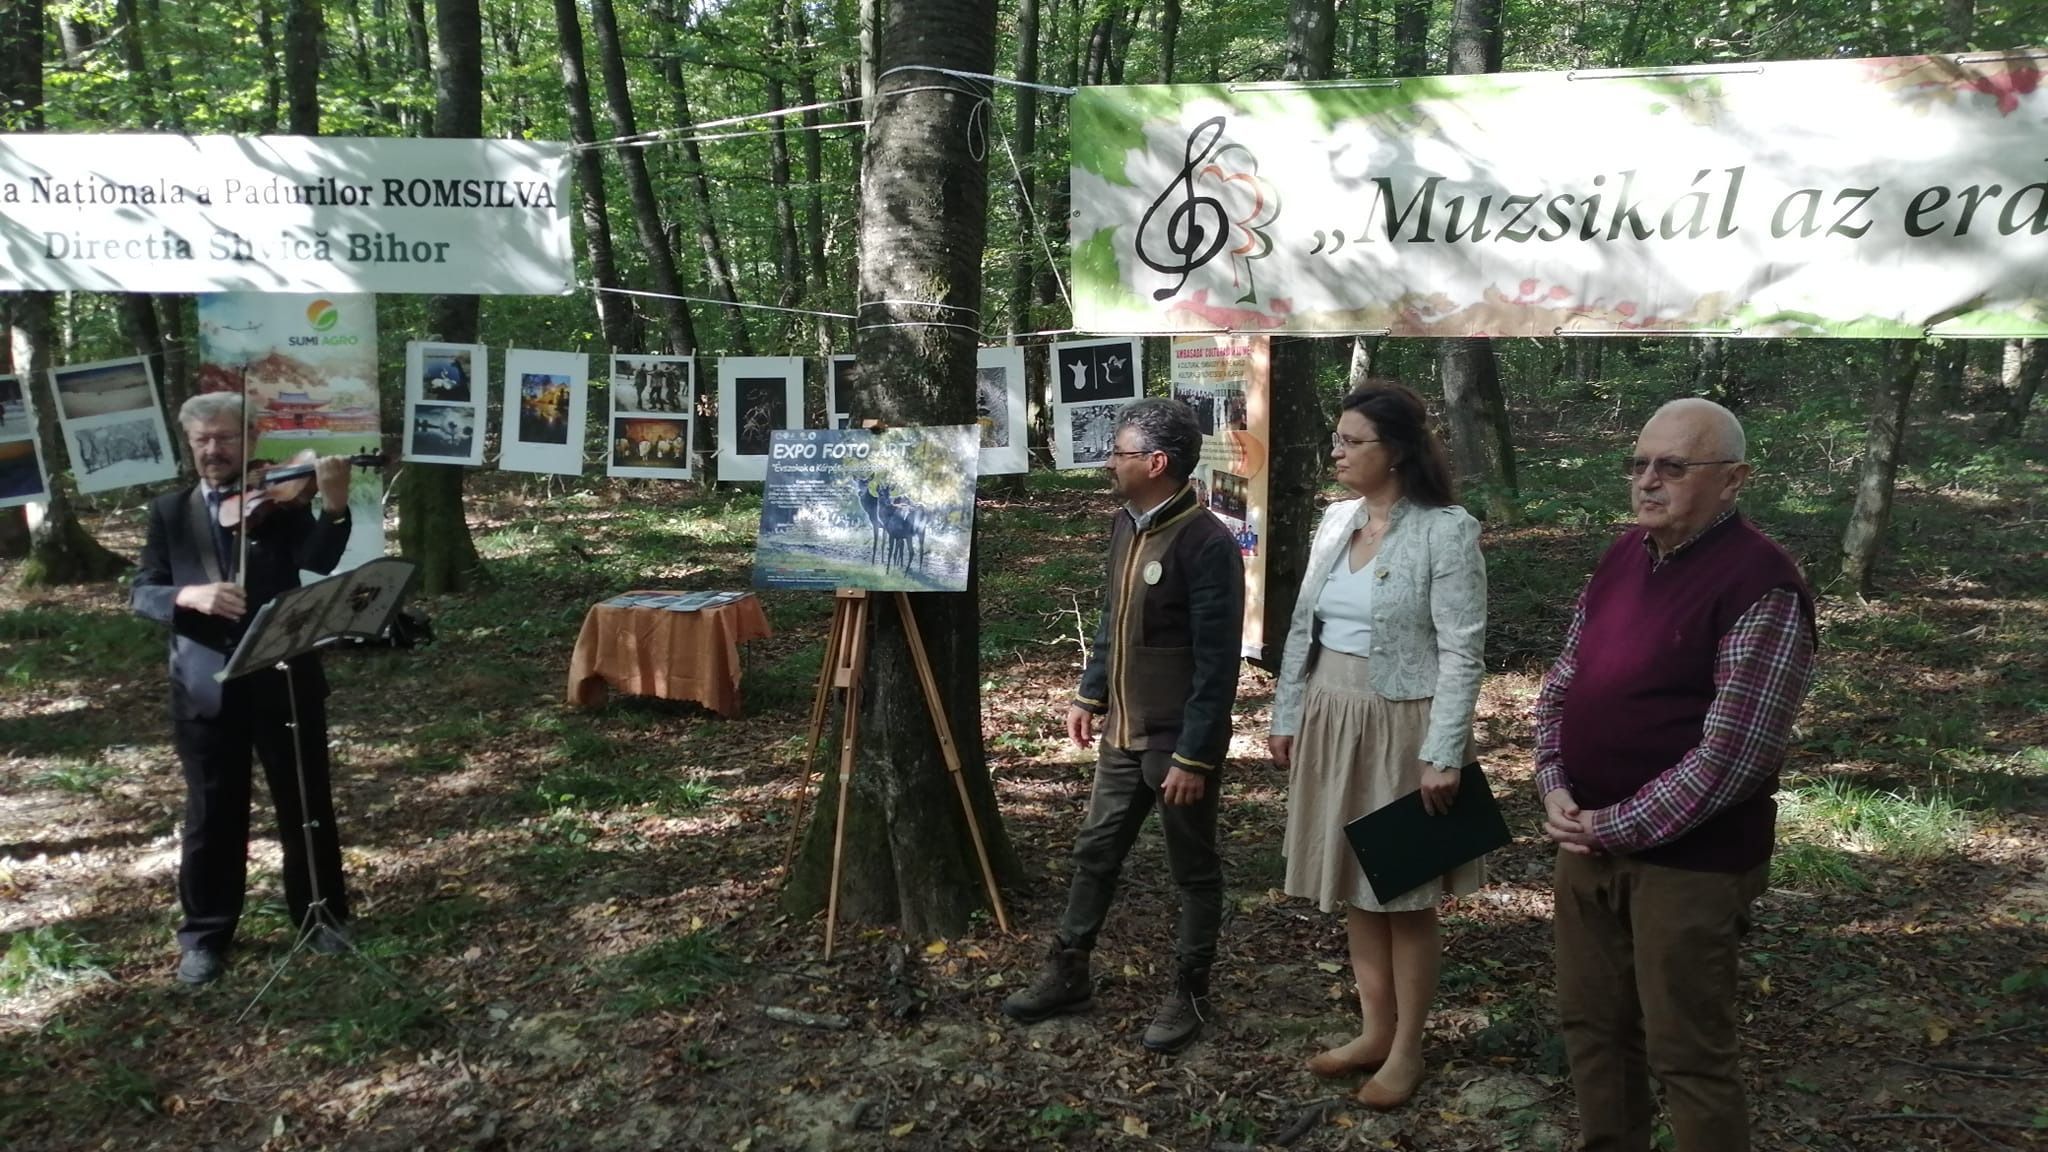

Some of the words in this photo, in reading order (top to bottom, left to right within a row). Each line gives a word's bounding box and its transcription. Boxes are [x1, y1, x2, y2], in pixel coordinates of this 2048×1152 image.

[196, 183, 212, 205] a
[382, 178, 557, 208] ROMSILVA
[1770, 185, 1880, 240] az
[347, 232, 450, 263] Bihor
[288, 336, 318, 346] SUMI
[321, 336, 358, 346] AGRO
[773, 443, 817, 459] EXPO
[822, 443, 870, 459] FOTO
[879, 442, 911, 458] ART
